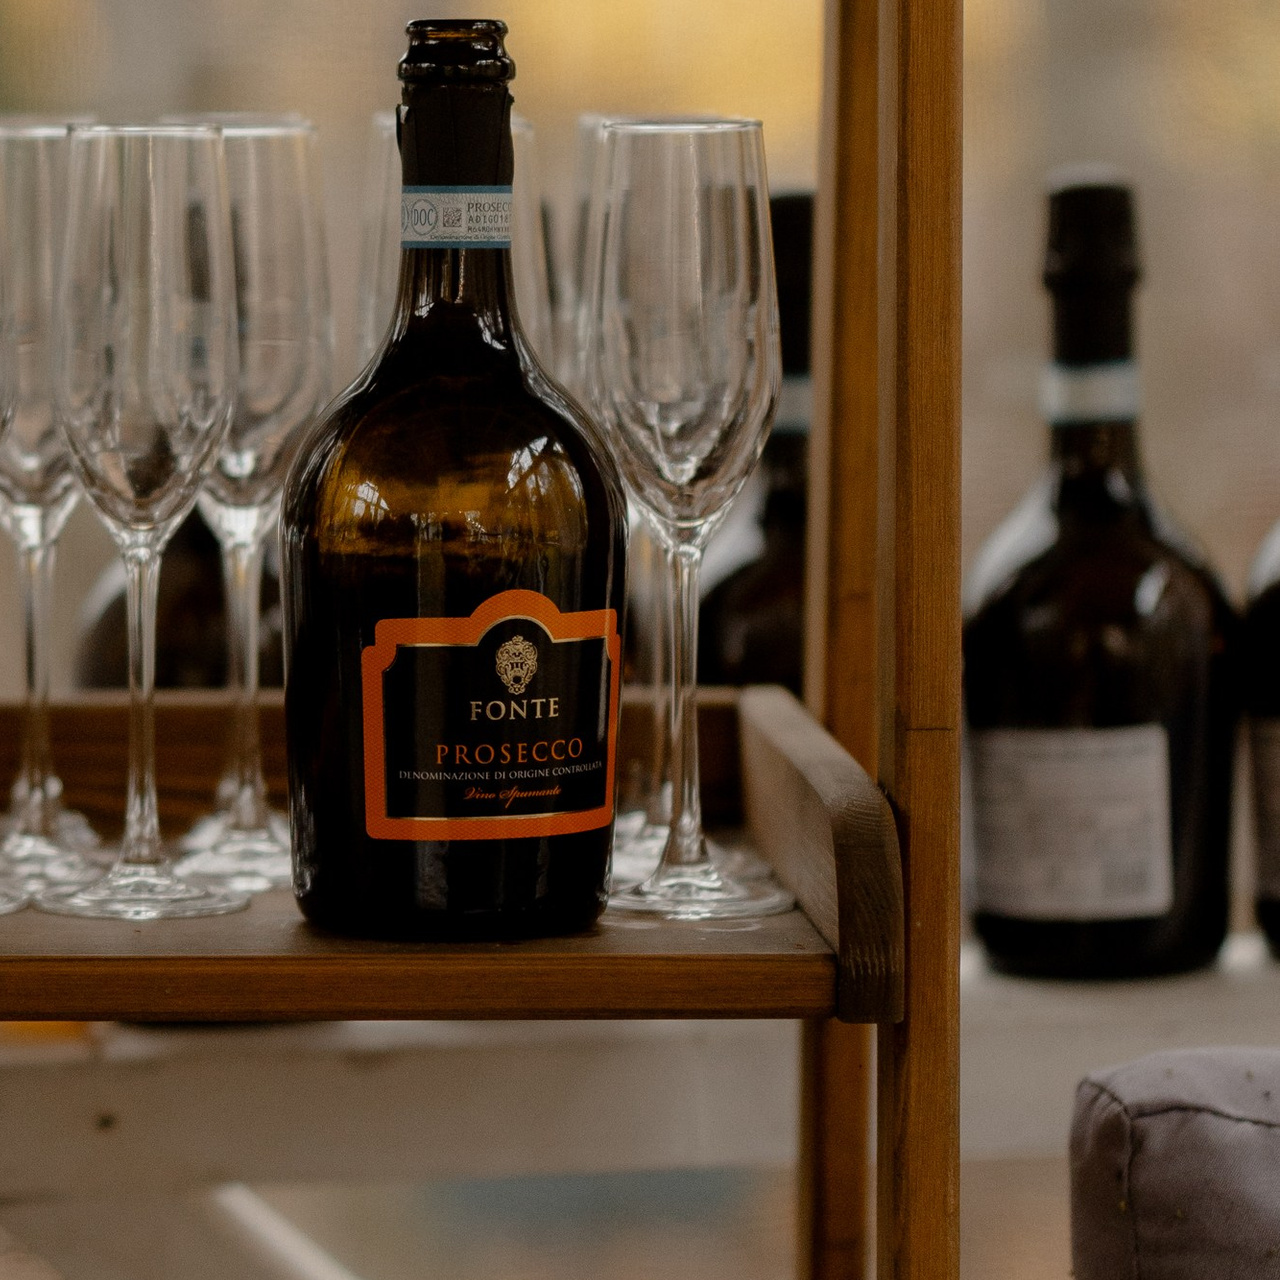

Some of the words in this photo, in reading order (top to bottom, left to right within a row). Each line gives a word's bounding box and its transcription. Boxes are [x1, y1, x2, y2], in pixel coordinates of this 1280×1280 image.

[413, 208, 433, 226] DOC
[470, 697, 560, 721] FONTE
[436, 737, 583, 765] PROSECCO
[399, 770, 491, 780] DENOMINAZIONE
[494, 771, 506, 780] DI
[508, 767, 550, 779] ORIGINE
[552, 761, 602, 776] CONTROLLATA
[463, 786, 496, 799] Vino
[499, 785, 562, 809] Spumante
